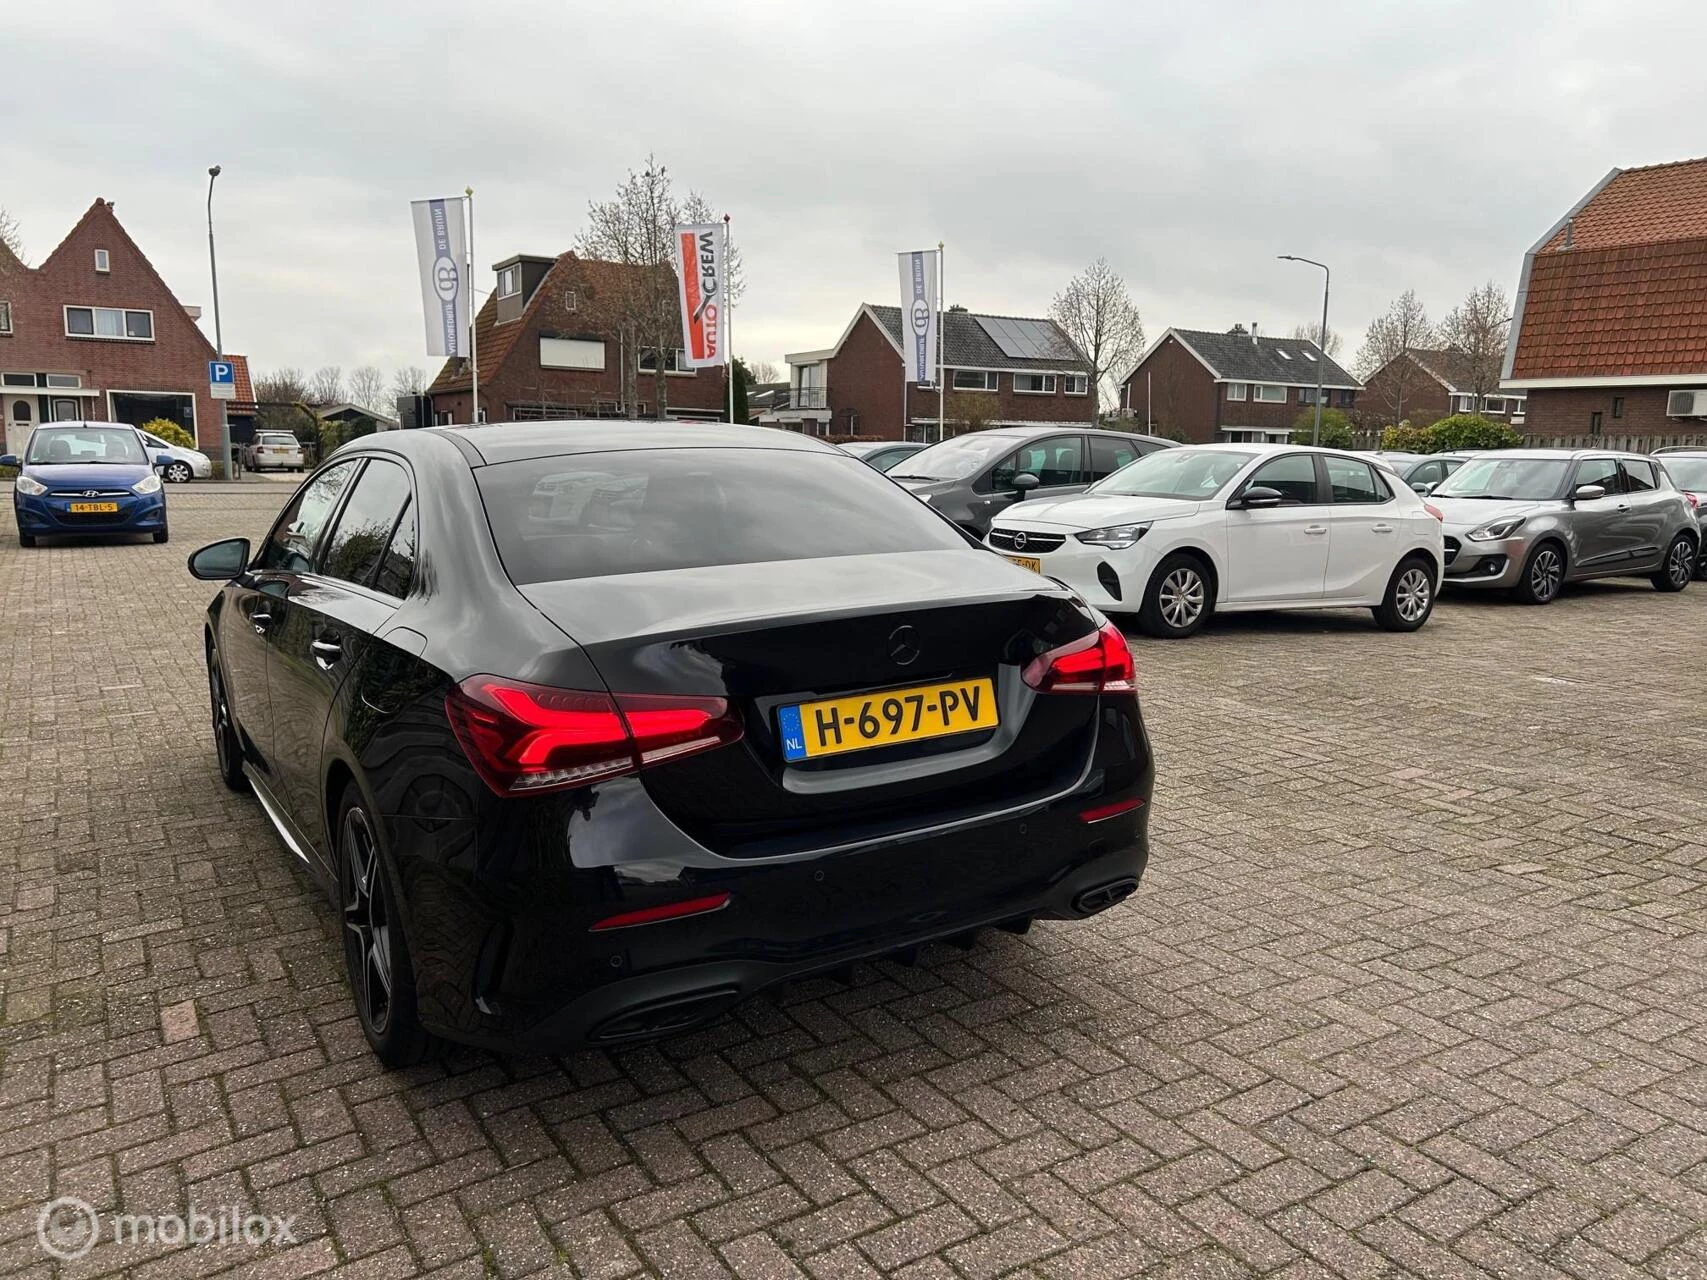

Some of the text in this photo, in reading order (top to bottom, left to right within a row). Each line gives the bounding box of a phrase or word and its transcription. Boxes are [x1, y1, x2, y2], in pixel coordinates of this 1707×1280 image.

[215, 364, 229, 381] P
[786, 686, 980, 750] NL H-697-PV
